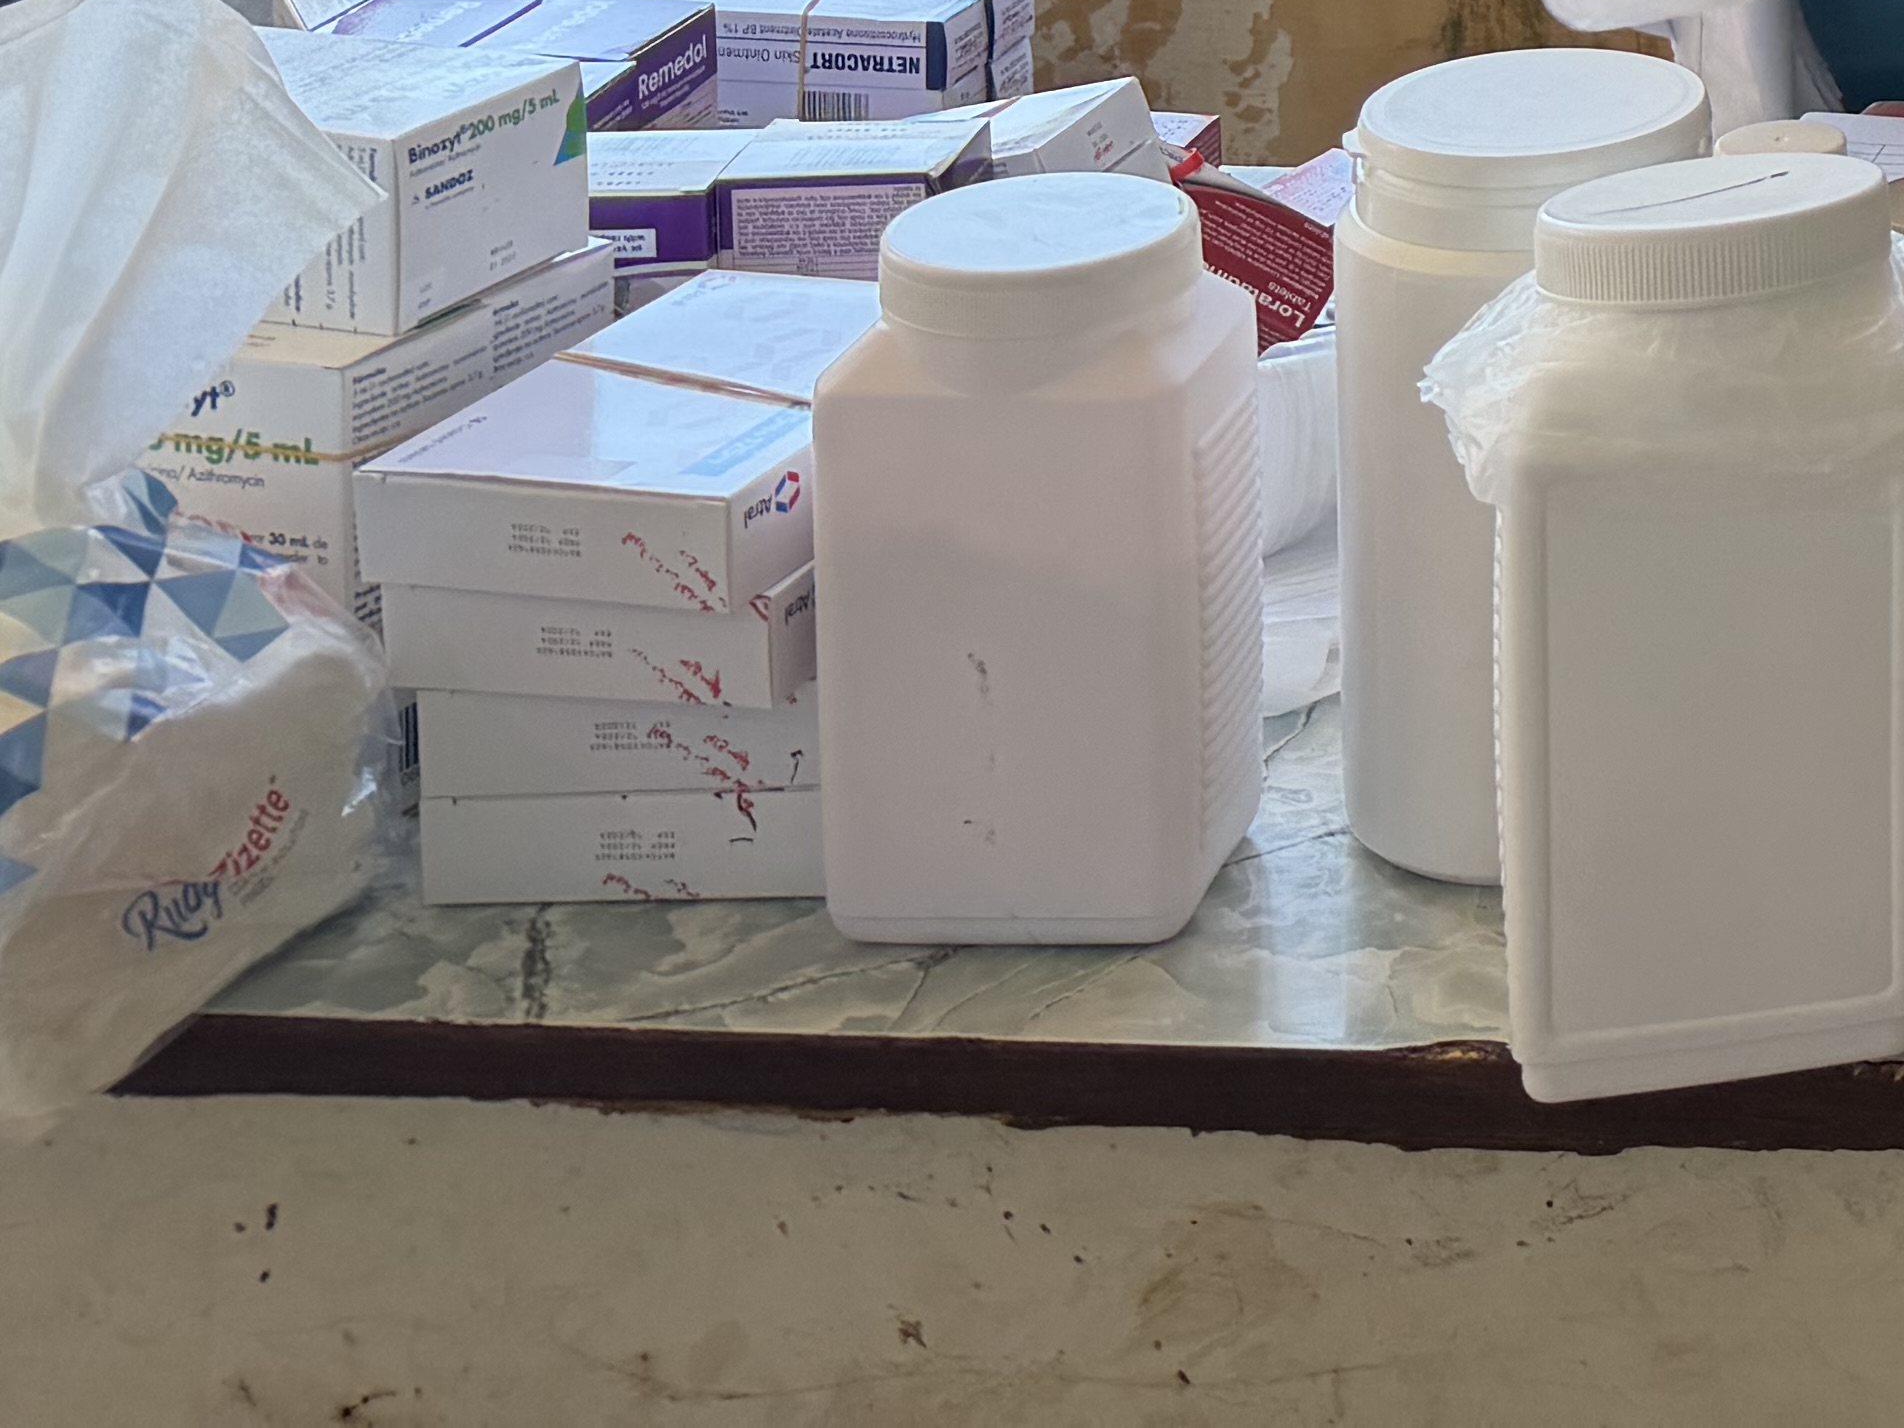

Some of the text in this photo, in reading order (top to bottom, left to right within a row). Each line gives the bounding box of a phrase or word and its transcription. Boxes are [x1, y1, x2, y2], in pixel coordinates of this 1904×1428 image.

[742, 22, 758, 36] BP
[637, 33, 708, 101] Remedol
[717, 45, 770, 63] Ointmen
[809, 52, 921, 74] NETRACORT
[467, 114, 496, 141] 200
[497, 96, 537, 128] mg/5
[540, 88, 560, 111] mL
[423, 168, 475, 200] SANDOZ
[1267, 281, 1311, 312] Tablets
[187, 468, 266, 490] Azithromycin
